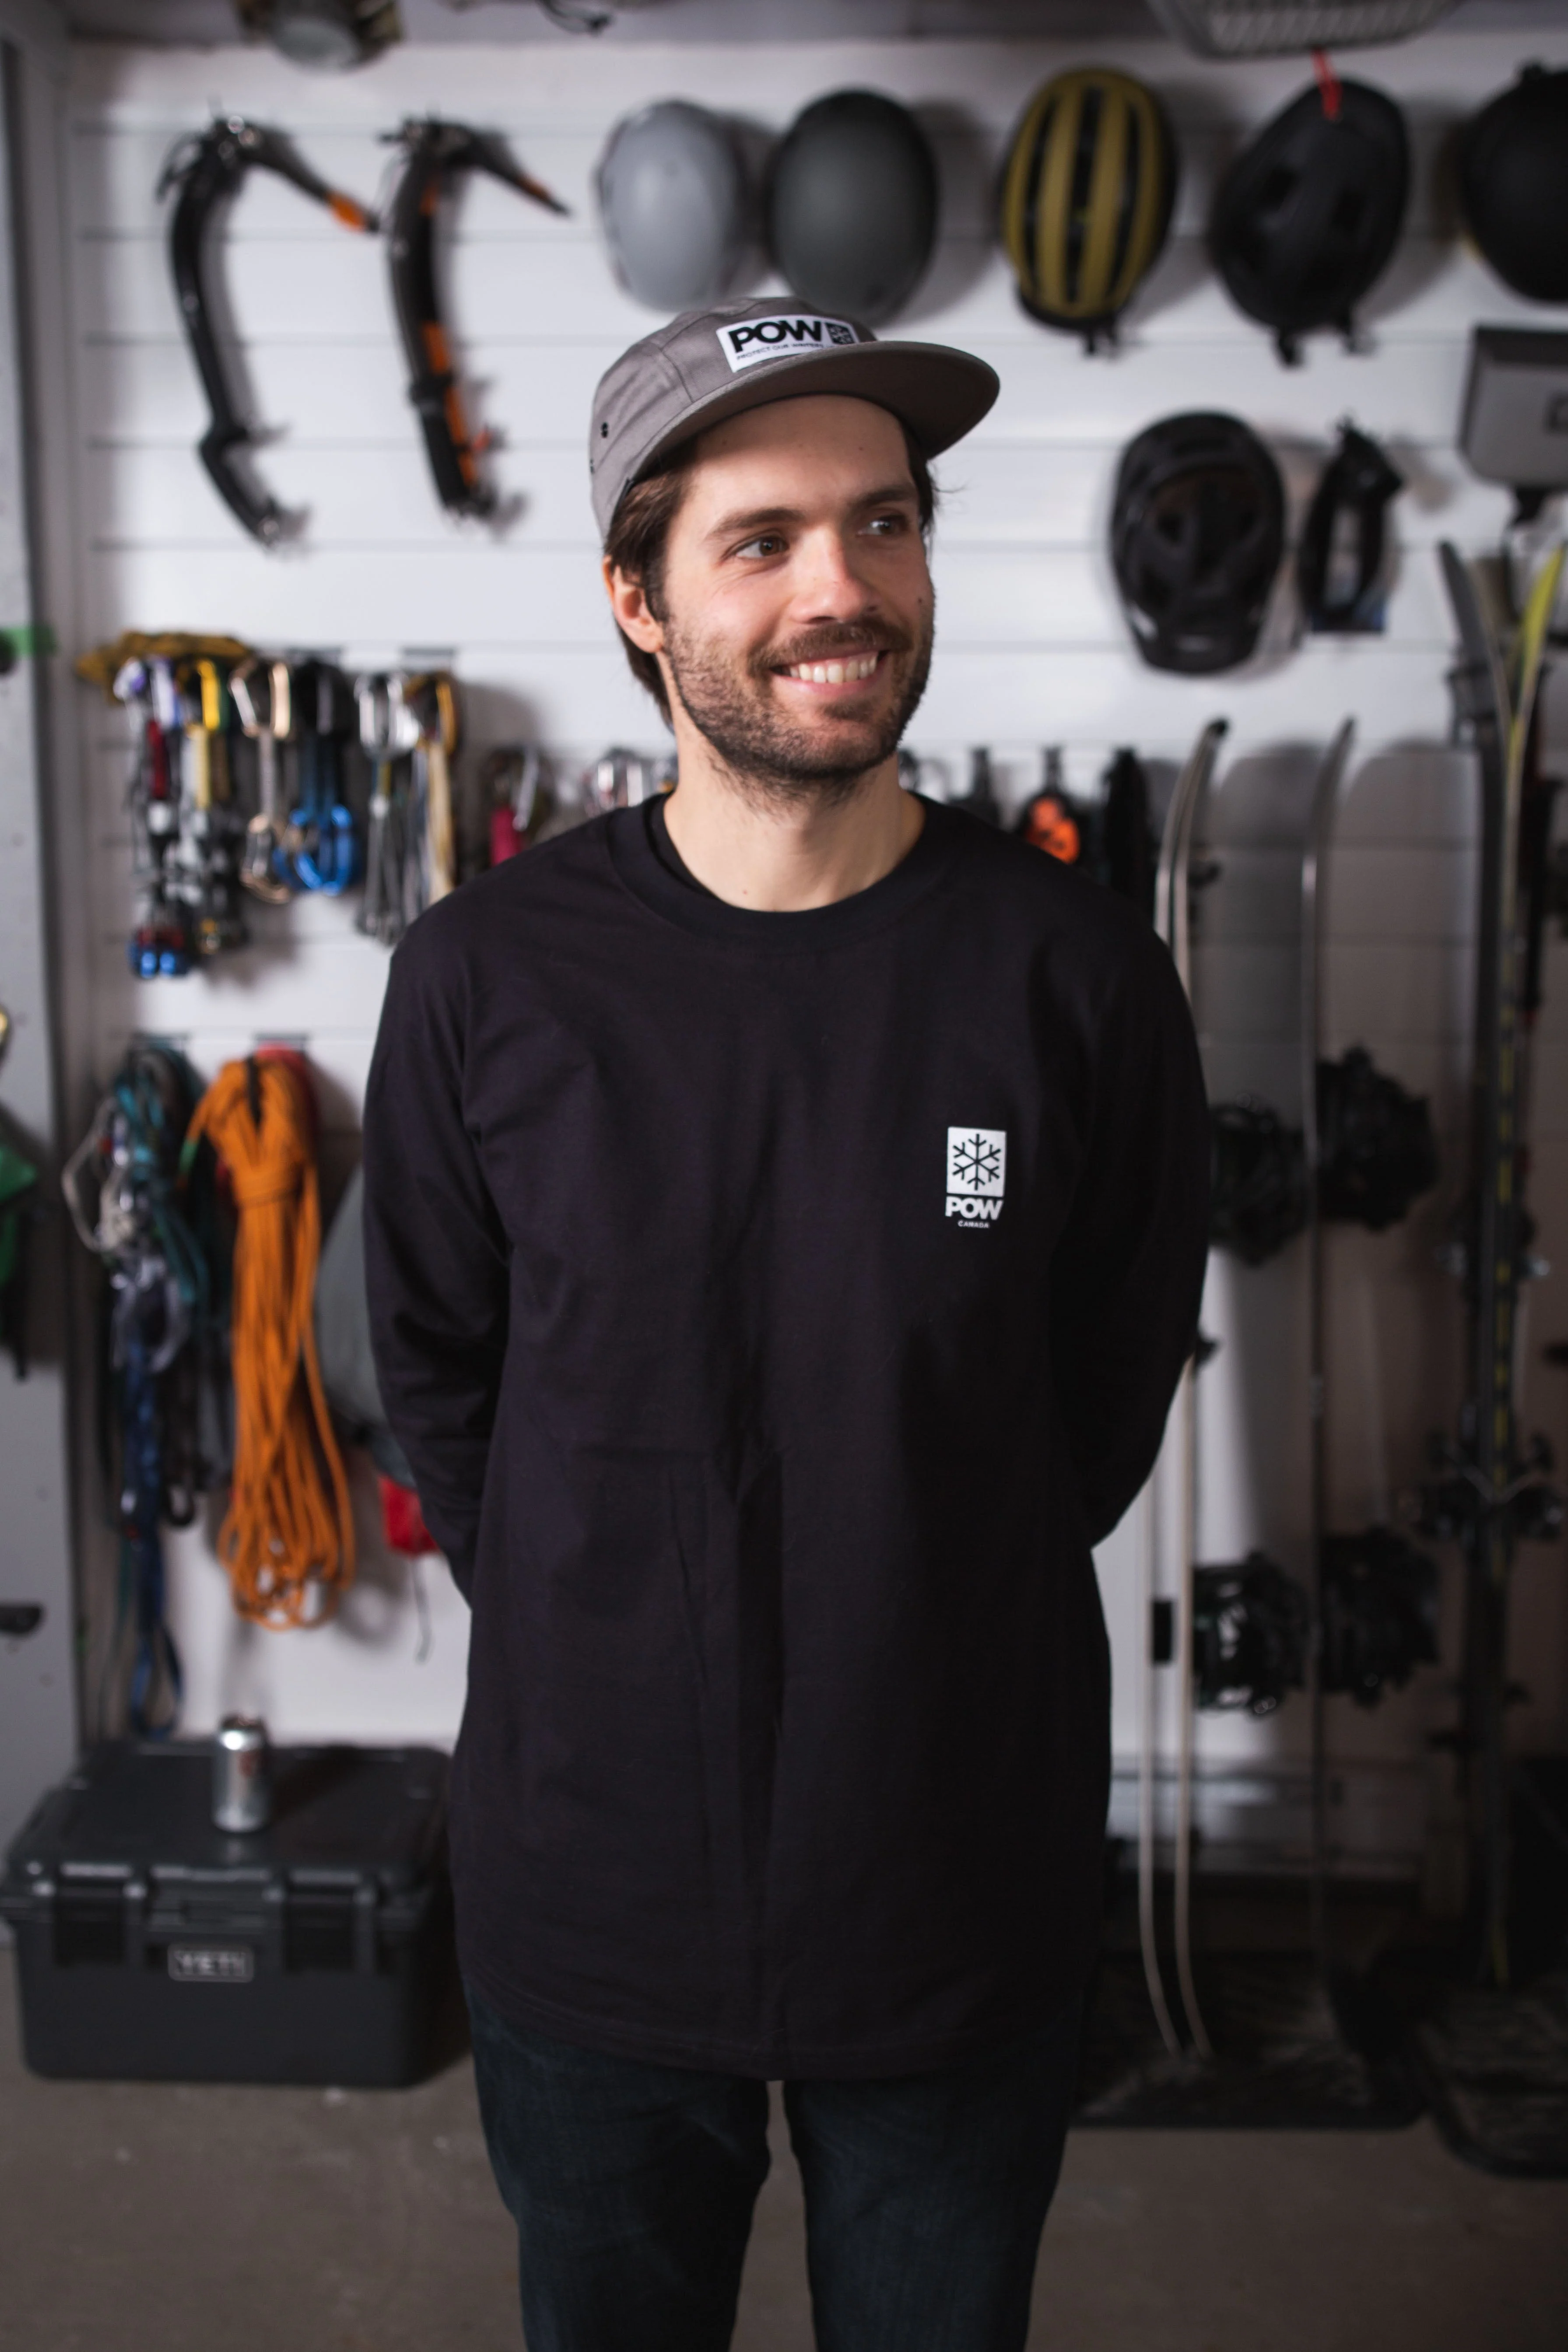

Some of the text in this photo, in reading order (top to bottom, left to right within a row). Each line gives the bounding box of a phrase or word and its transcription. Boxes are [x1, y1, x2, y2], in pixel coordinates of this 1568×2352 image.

[728, 320, 821, 352] POW
[737, 347, 770, 360] PROTECT
[945, 1196, 1003, 1220] POW
[174, 1950, 246, 1976] YETI
